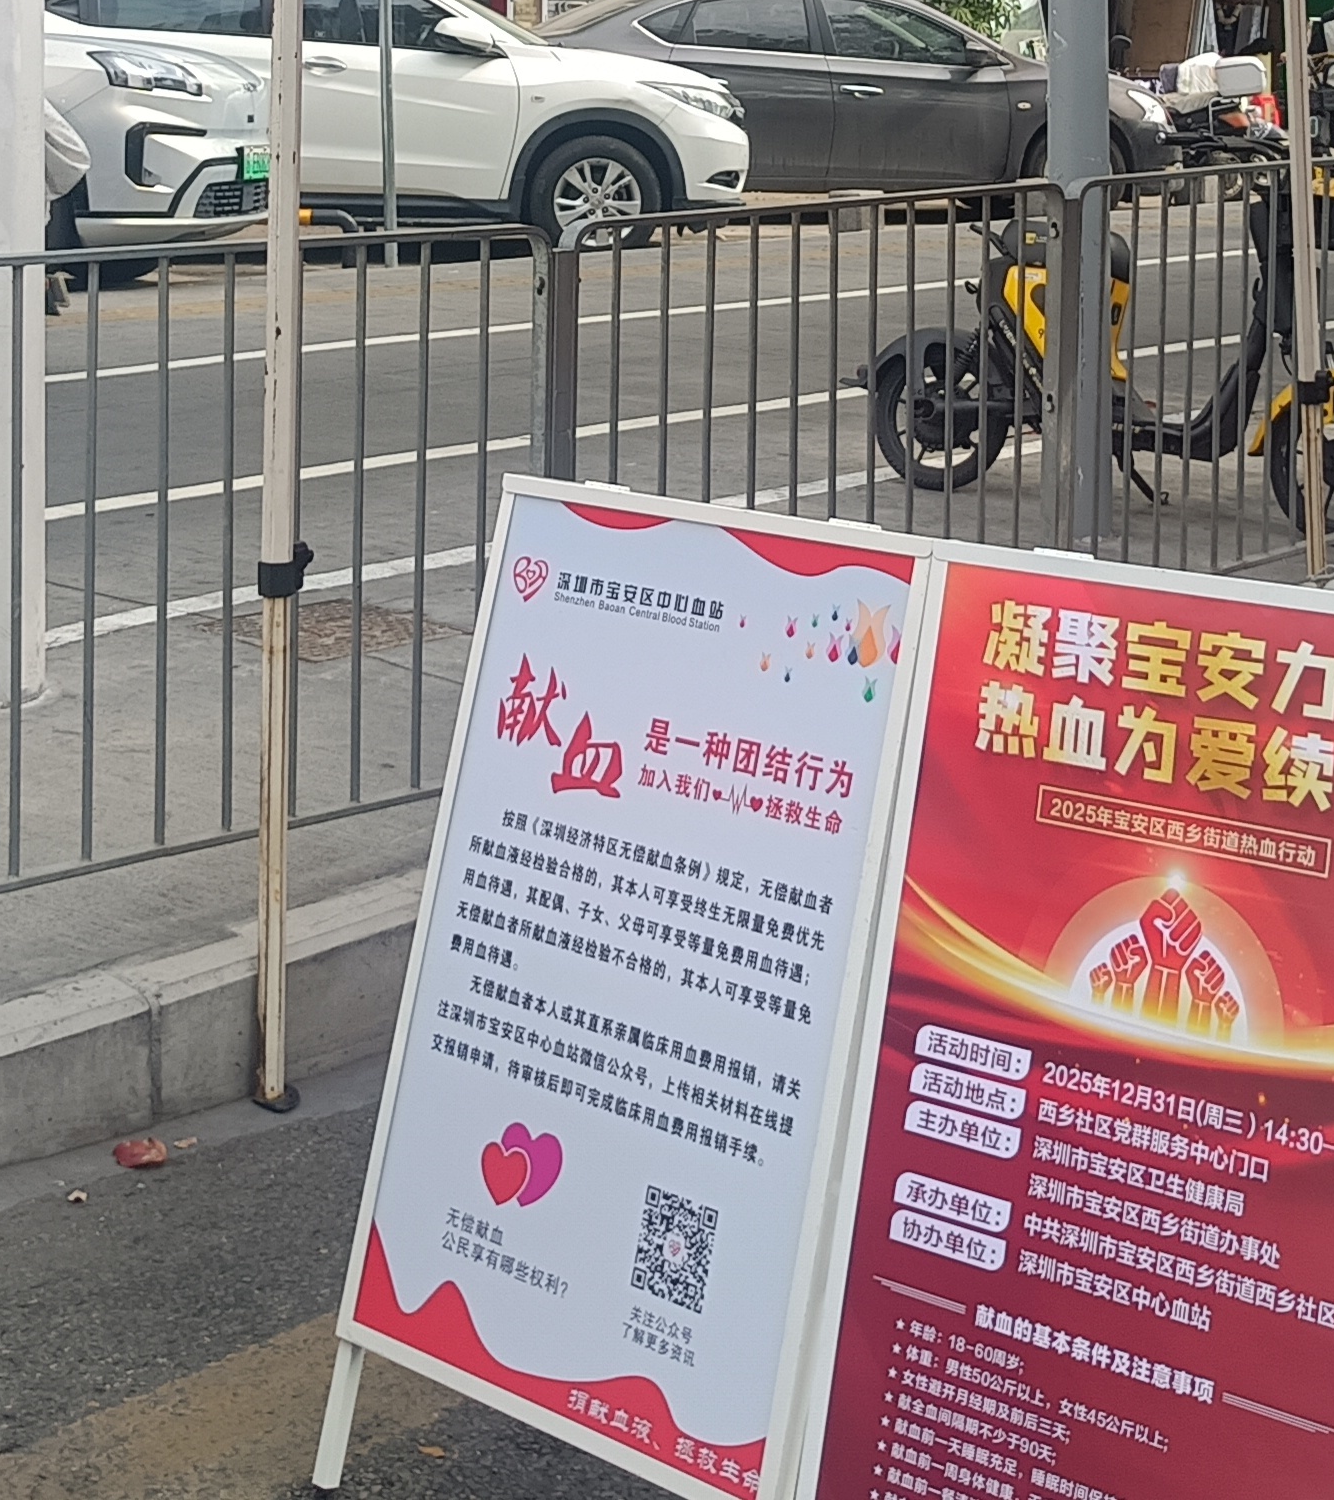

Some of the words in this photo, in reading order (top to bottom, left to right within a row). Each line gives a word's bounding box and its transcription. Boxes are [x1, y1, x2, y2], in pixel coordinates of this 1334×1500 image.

[554, 592, 595, 608] Shenzhen
[598, 600, 625, 614] Baoan
[629, 606, 660, 621] Central
[661, 613, 687, 626] Blood
[688, 617, 720, 632] Station
[557, 571, 724, 620] 深圳市宝安区中心血站
[497, 652, 622, 799] 献血
[644, 717, 854, 799] 是一种团结行为
[638, 764, 710, 802] 加入我们
[764, 793, 843, 835] 拯救生命
[1049, 797, 1317, 868] 2025年宝安区西乡街道热血行动
[450, 934, 519, 972] 费用血待遇。
[927, 1031, 1024, 1076] 活动时间：
[922, 1069, 1018, 1114] 活动地点：
[1038, 1098, 1270, 1183] 西乡社区党群服务中心门口
[917, 1107, 1013, 1154] 主办单位：
[1033, 1137, 1245, 1218] 深圳市宝安区卫生健康局
[446, 1206, 504, 1247] 无偿献血
[905, 1179, 1003, 1228] 承办单位：
[1028, 1173, 1280, 1270] 深圳市宝安区西乡街道办事处
[901, 1217, 998, 1267] 协办单位：
[1018, 1249, 1212, 1333] 深圳市宝安区中心血站
[622, 1321, 696, 1368] 了解更多资讯
[629, 1306, 693, 1345] 关注公众号
[974, 1305, 1215, 1404] 献血的基本条件及注意事项
